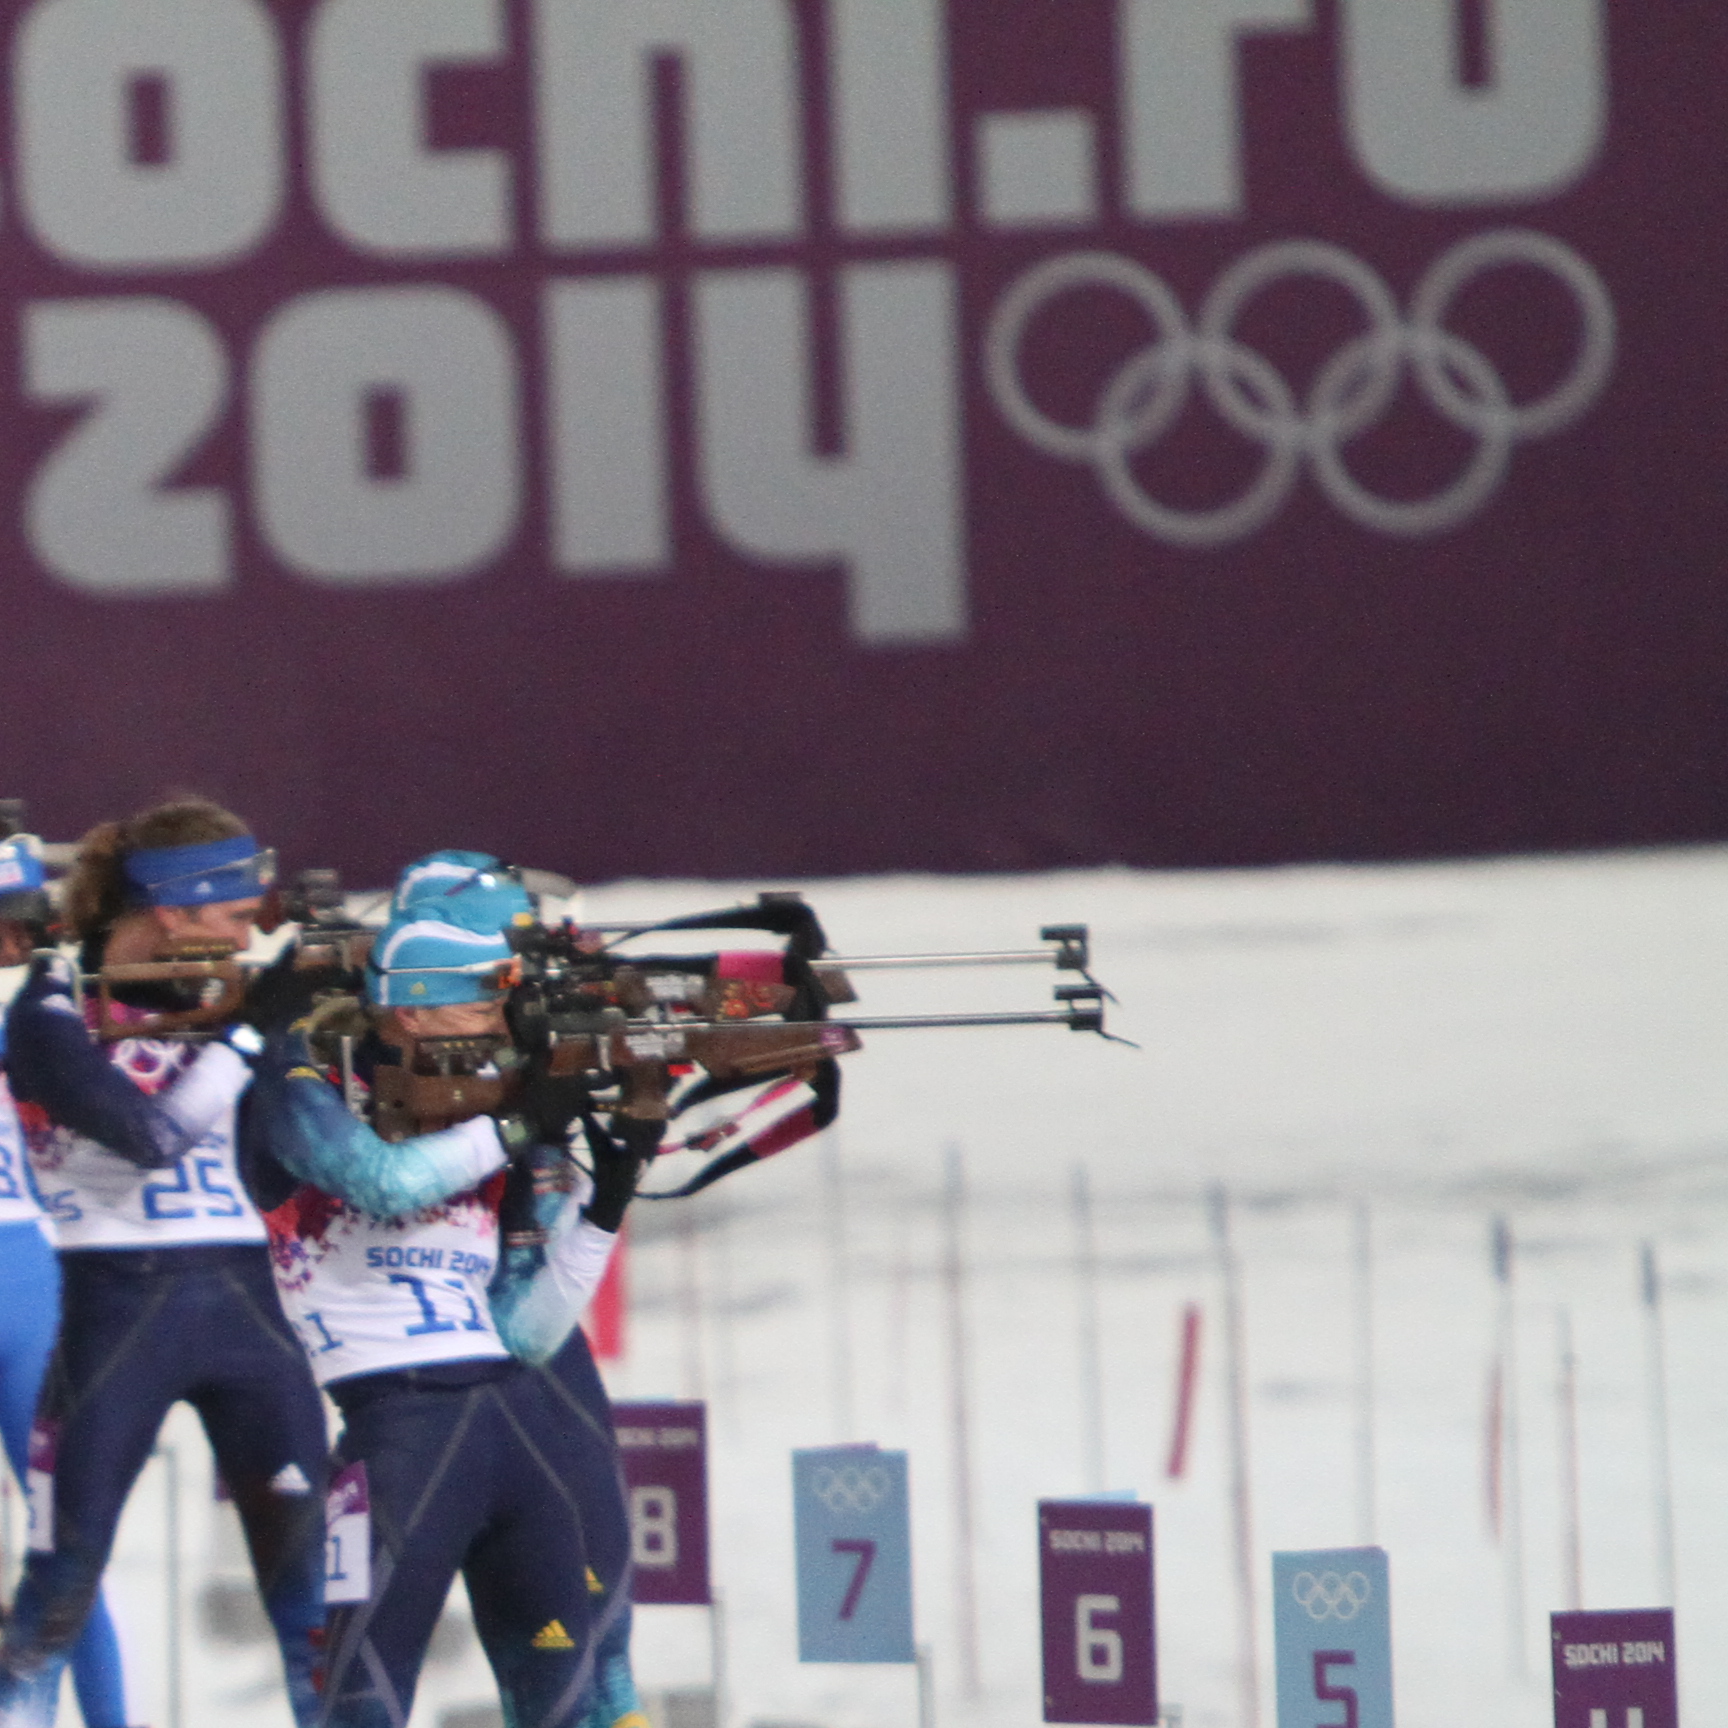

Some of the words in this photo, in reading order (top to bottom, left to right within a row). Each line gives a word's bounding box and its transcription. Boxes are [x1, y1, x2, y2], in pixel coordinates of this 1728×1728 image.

[21, 257, 968, 646] 2014
[141, 1156, 244, 1221] 25
[365, 1246, 443, 1269] SOCHI
[630, 1484, 678, 1566] 8
[831, 1538, 877, 1621] 7
[1075, 1593, 1124, 1682] 6
[1563, 1643, 1619, 1668] SOCHI
[1622, 1640, 1666, 1664] 2014
